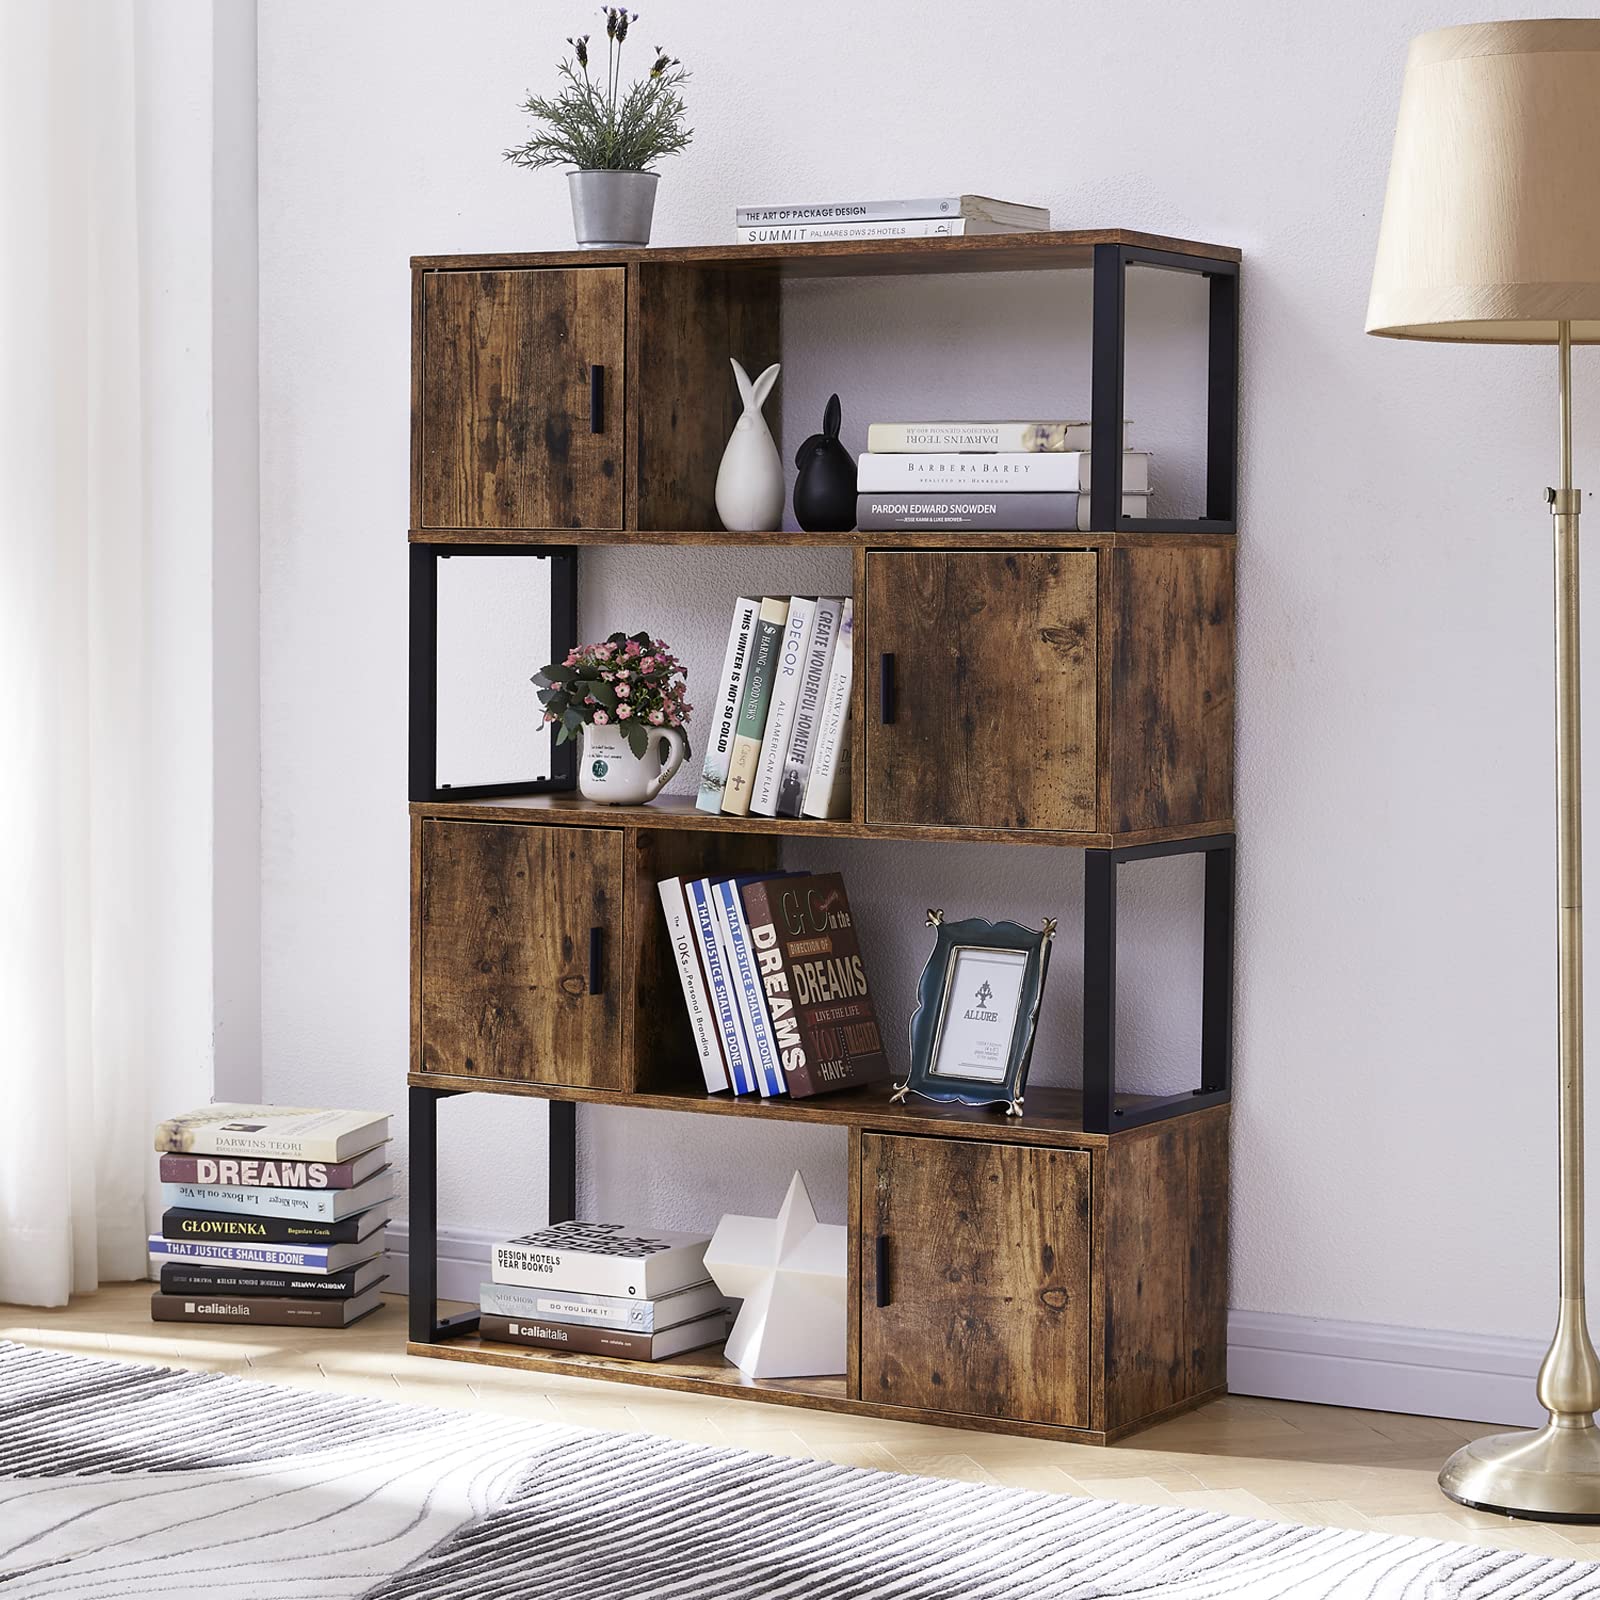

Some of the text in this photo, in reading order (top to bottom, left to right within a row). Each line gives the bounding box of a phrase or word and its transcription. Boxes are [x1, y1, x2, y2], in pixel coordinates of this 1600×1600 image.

[746, 205, 867, 222] THE ART OF PACKAGE DESIGN
[748, 226, 906, 243] SUMMIT PALMARES DWS 25 HOTELS
[906, 434, 999, 445] DARWINS TEORI
[908, 462, 1031, 473] BARBERA BAREY
[871, 503, 997, 515] PARDON EDWARD SNOWDEN
[782, 619, 804, 677] DECOR
[717, 609, 753, 753] THIS WINTER IS NOT SO COLOD
[750, 675, 763, 700] GOOD
[790, 609, 834, 765] CREATE WONDERFUL HOMELIFE
[746, 699, 757, 721] NEWS
[829, 674, 847, 734] DARWINS
[760, 700, 786, 804] ALL-AMERICAN FLAIR
[820, 735, 837, 778] TEORI
[828, 911, 836, 929] in
[837, 911, 852, 929] the
[789, 939, 829, 955] DIRECTION OF
[697, 901, 742, 1067] THAT JUSTICE SHALL BE DONE
[726, 904, 773, 1071] THAT JUSTICE SHALL BE DONE
[792, 954, 868, 1006] DREAMS
[676, 934, 689, 966] 10Ks
[686, 974, 701, 1015] Personal
[696, 1017, 710, 1058] Branding
[751, 922, 807, 1072] DREAMS
[814, 1006, 861, 1022] LIVE THE LIFE
[964, 1009, 999, 1023] ALLURE
[811, 1026, 845, 1061] YOU
[820, 1060, 846, 1081] HAVE
[215, 1137, 303, 1151] DARWINS TEORI
[196, 1159, 328, 1187] DREAMS
[179, 1187, 259, 1204] La Boxe ou la Vie
[291, 1199, 309, 1209] Noah
[181, 1220, 267, 1236] GŁOWIENKA
[507, 1221, 597, 1246] DESIGN
[534, 1223, 625, 1249] HOTELS
[166, 1243, 305, 1265] THAT JUSTICE SHALL BE DONE
[590, 1237, 661, 1255] BOOK
[498, 1249, 561, 1266] DESIGN HOTELS
[498, 1259, 554, 1274] YEAR BOOK09
[238, 1278, 258, 1286] DESIGN
[260, 1279, 285, 1287] INTERIOR
[290, 1281, 346, 1290] ANDREW MARTIN
[496, 1294, 534, 1305] SIDESHOW
[197, 1303, 250, 1316] caliaitalia
[564, 1304, 579, 1312] YOU
[581, 1306, 598, 1314] LIKE
[520, 1324, 569, 1342] caliaitalia
